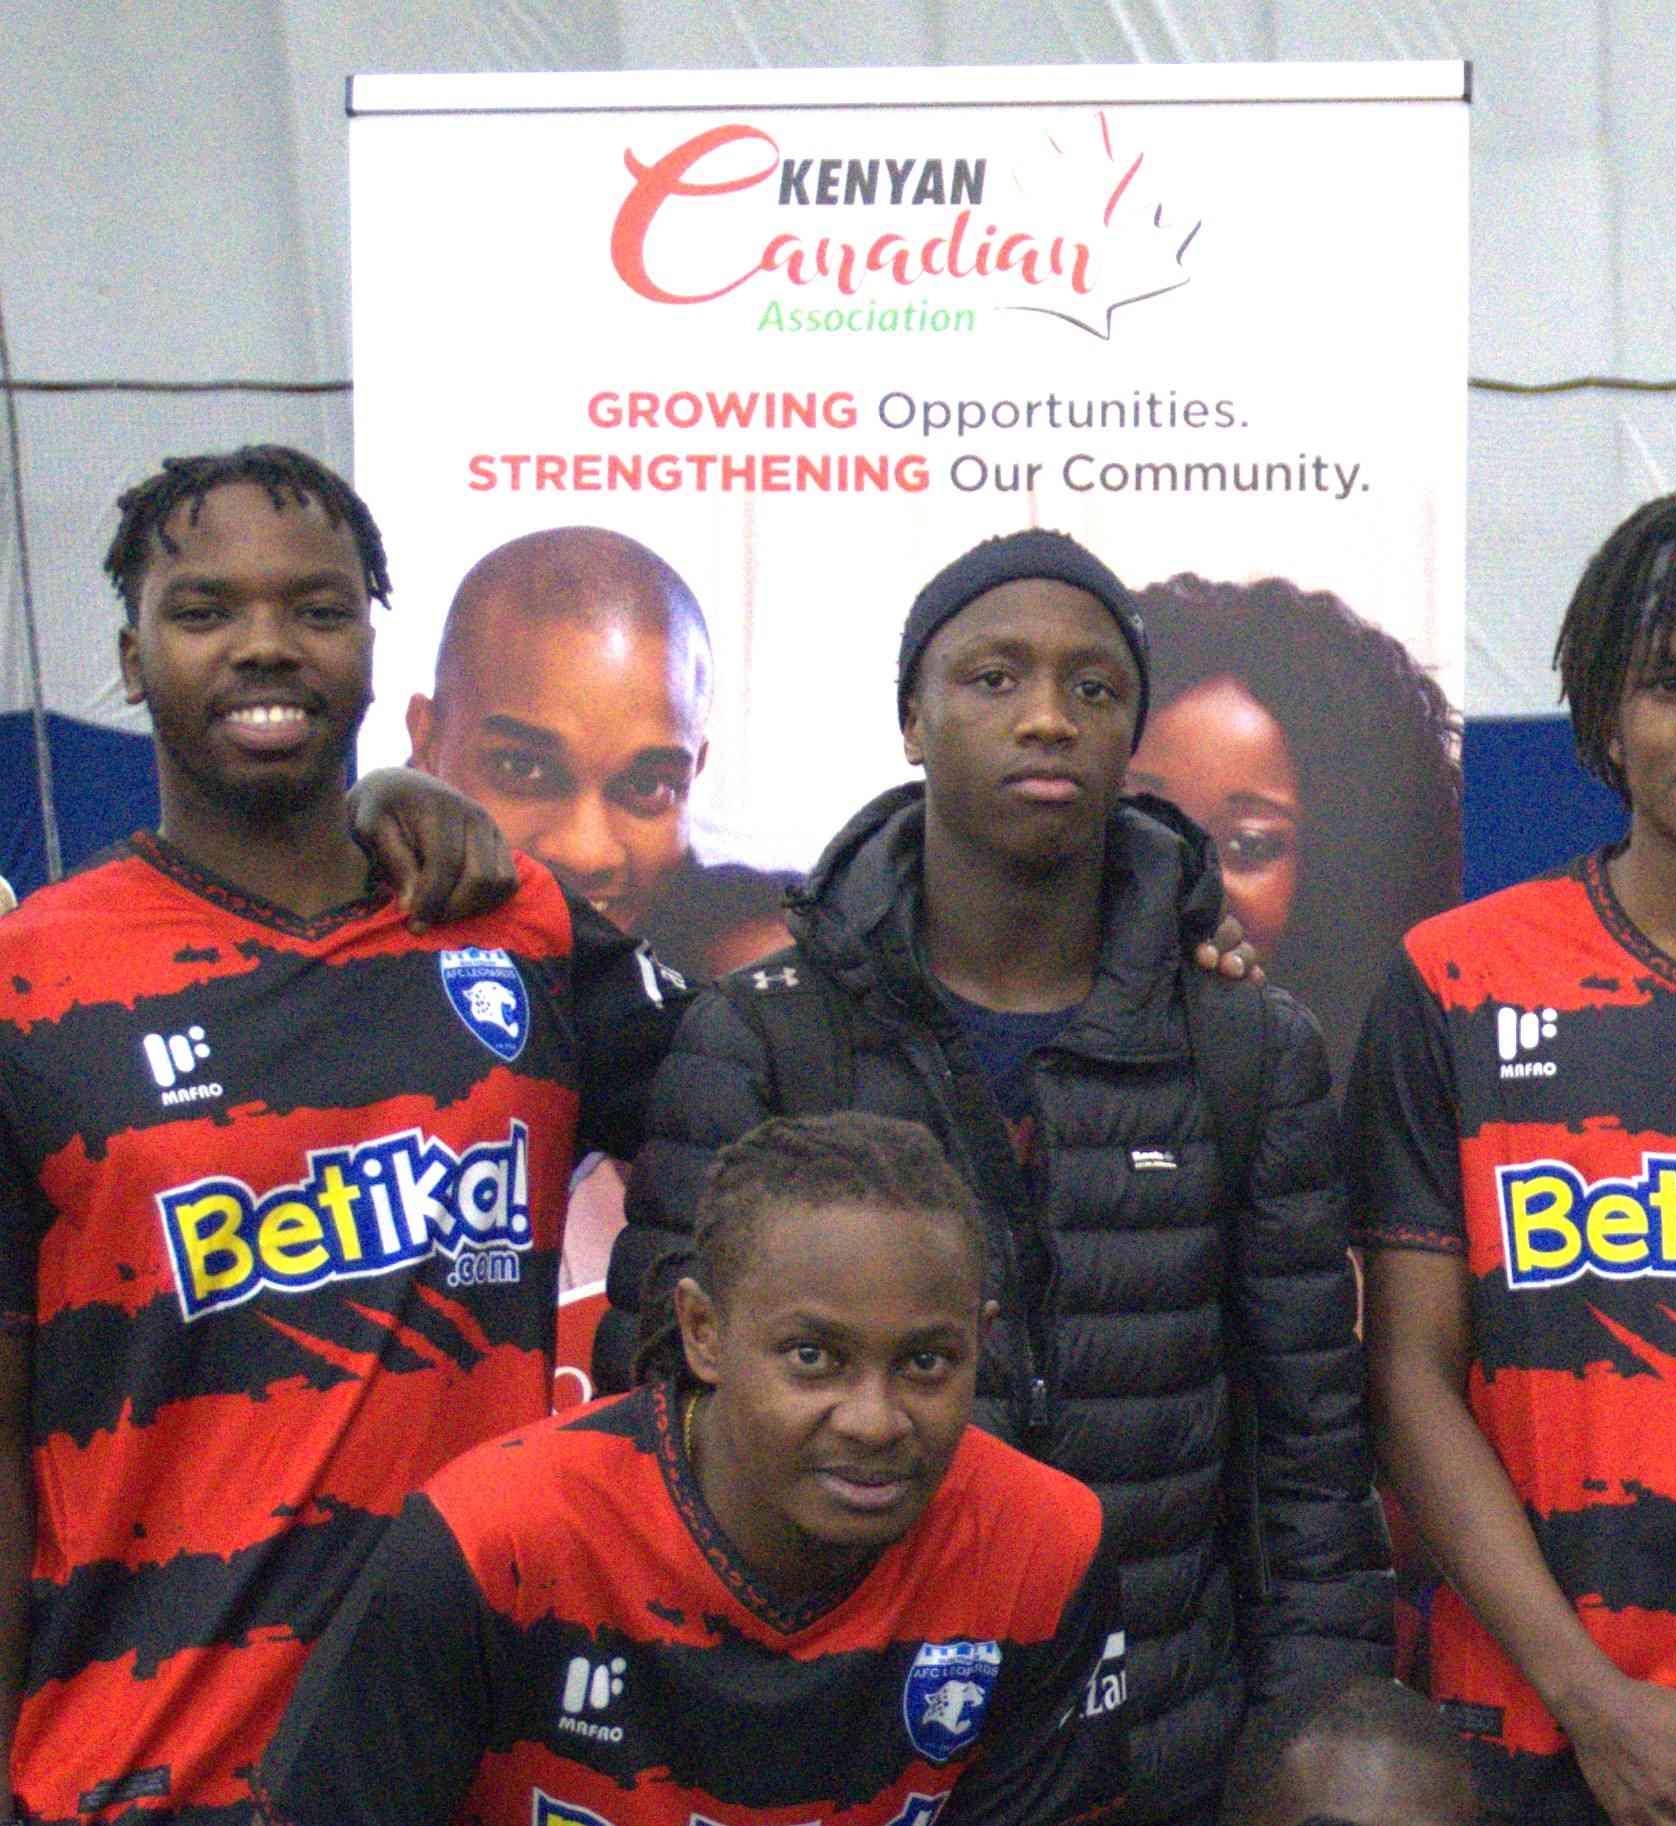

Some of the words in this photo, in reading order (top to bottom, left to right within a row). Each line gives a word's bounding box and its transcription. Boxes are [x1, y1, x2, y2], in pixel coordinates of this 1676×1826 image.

[777, 158, 987, 206] KENYAN
[610, 124, 1094, 306] Canadian
[757, 299, 977, 336] Association
[586, 391, 859, 432] GROWING
[876, 389, 1249, 439] Opportunities.
[466, 453, 932, 495] STRENGTHENING
[949, 456, 1044, 495] Our
[1063, 455, 1373, 501] Community.
[172, 1122, 532, 1303] Betika!
[447, 1250, 521, 1289] .com
